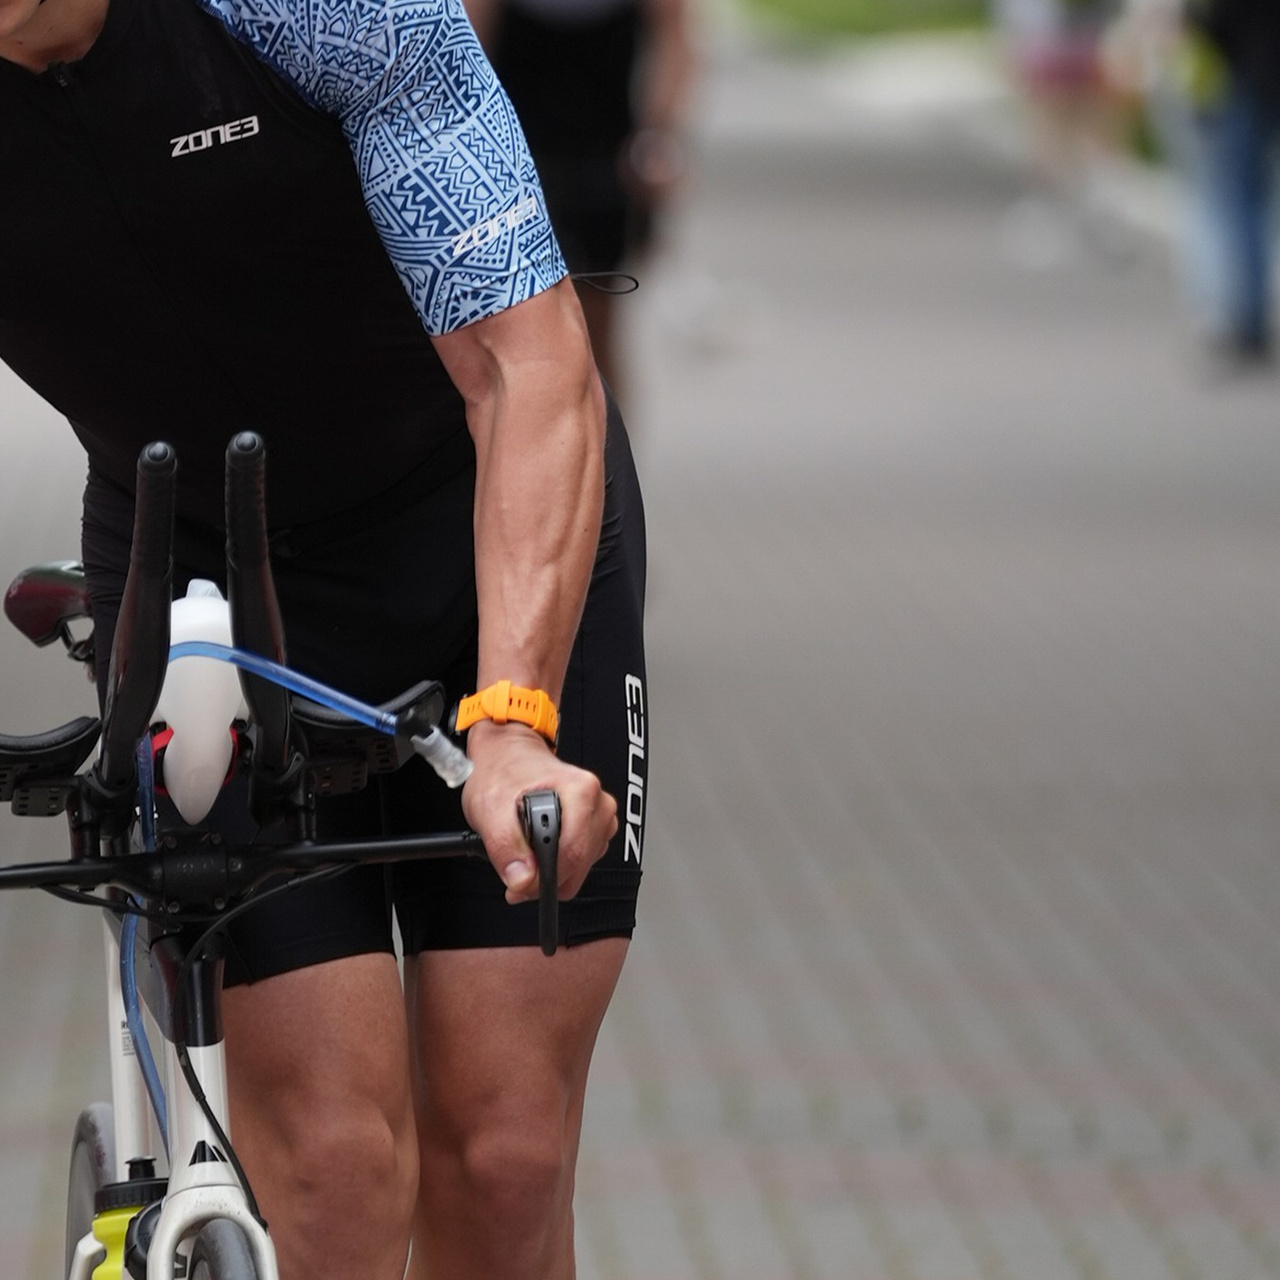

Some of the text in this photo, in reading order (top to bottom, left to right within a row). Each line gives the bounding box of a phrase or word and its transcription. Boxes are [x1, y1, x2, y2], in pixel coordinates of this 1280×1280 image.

[170, 115, 259, 157] ZONE3
[451, 198, 537, 257] ZONE3
[624, 673, 645, 864] ZONE3
